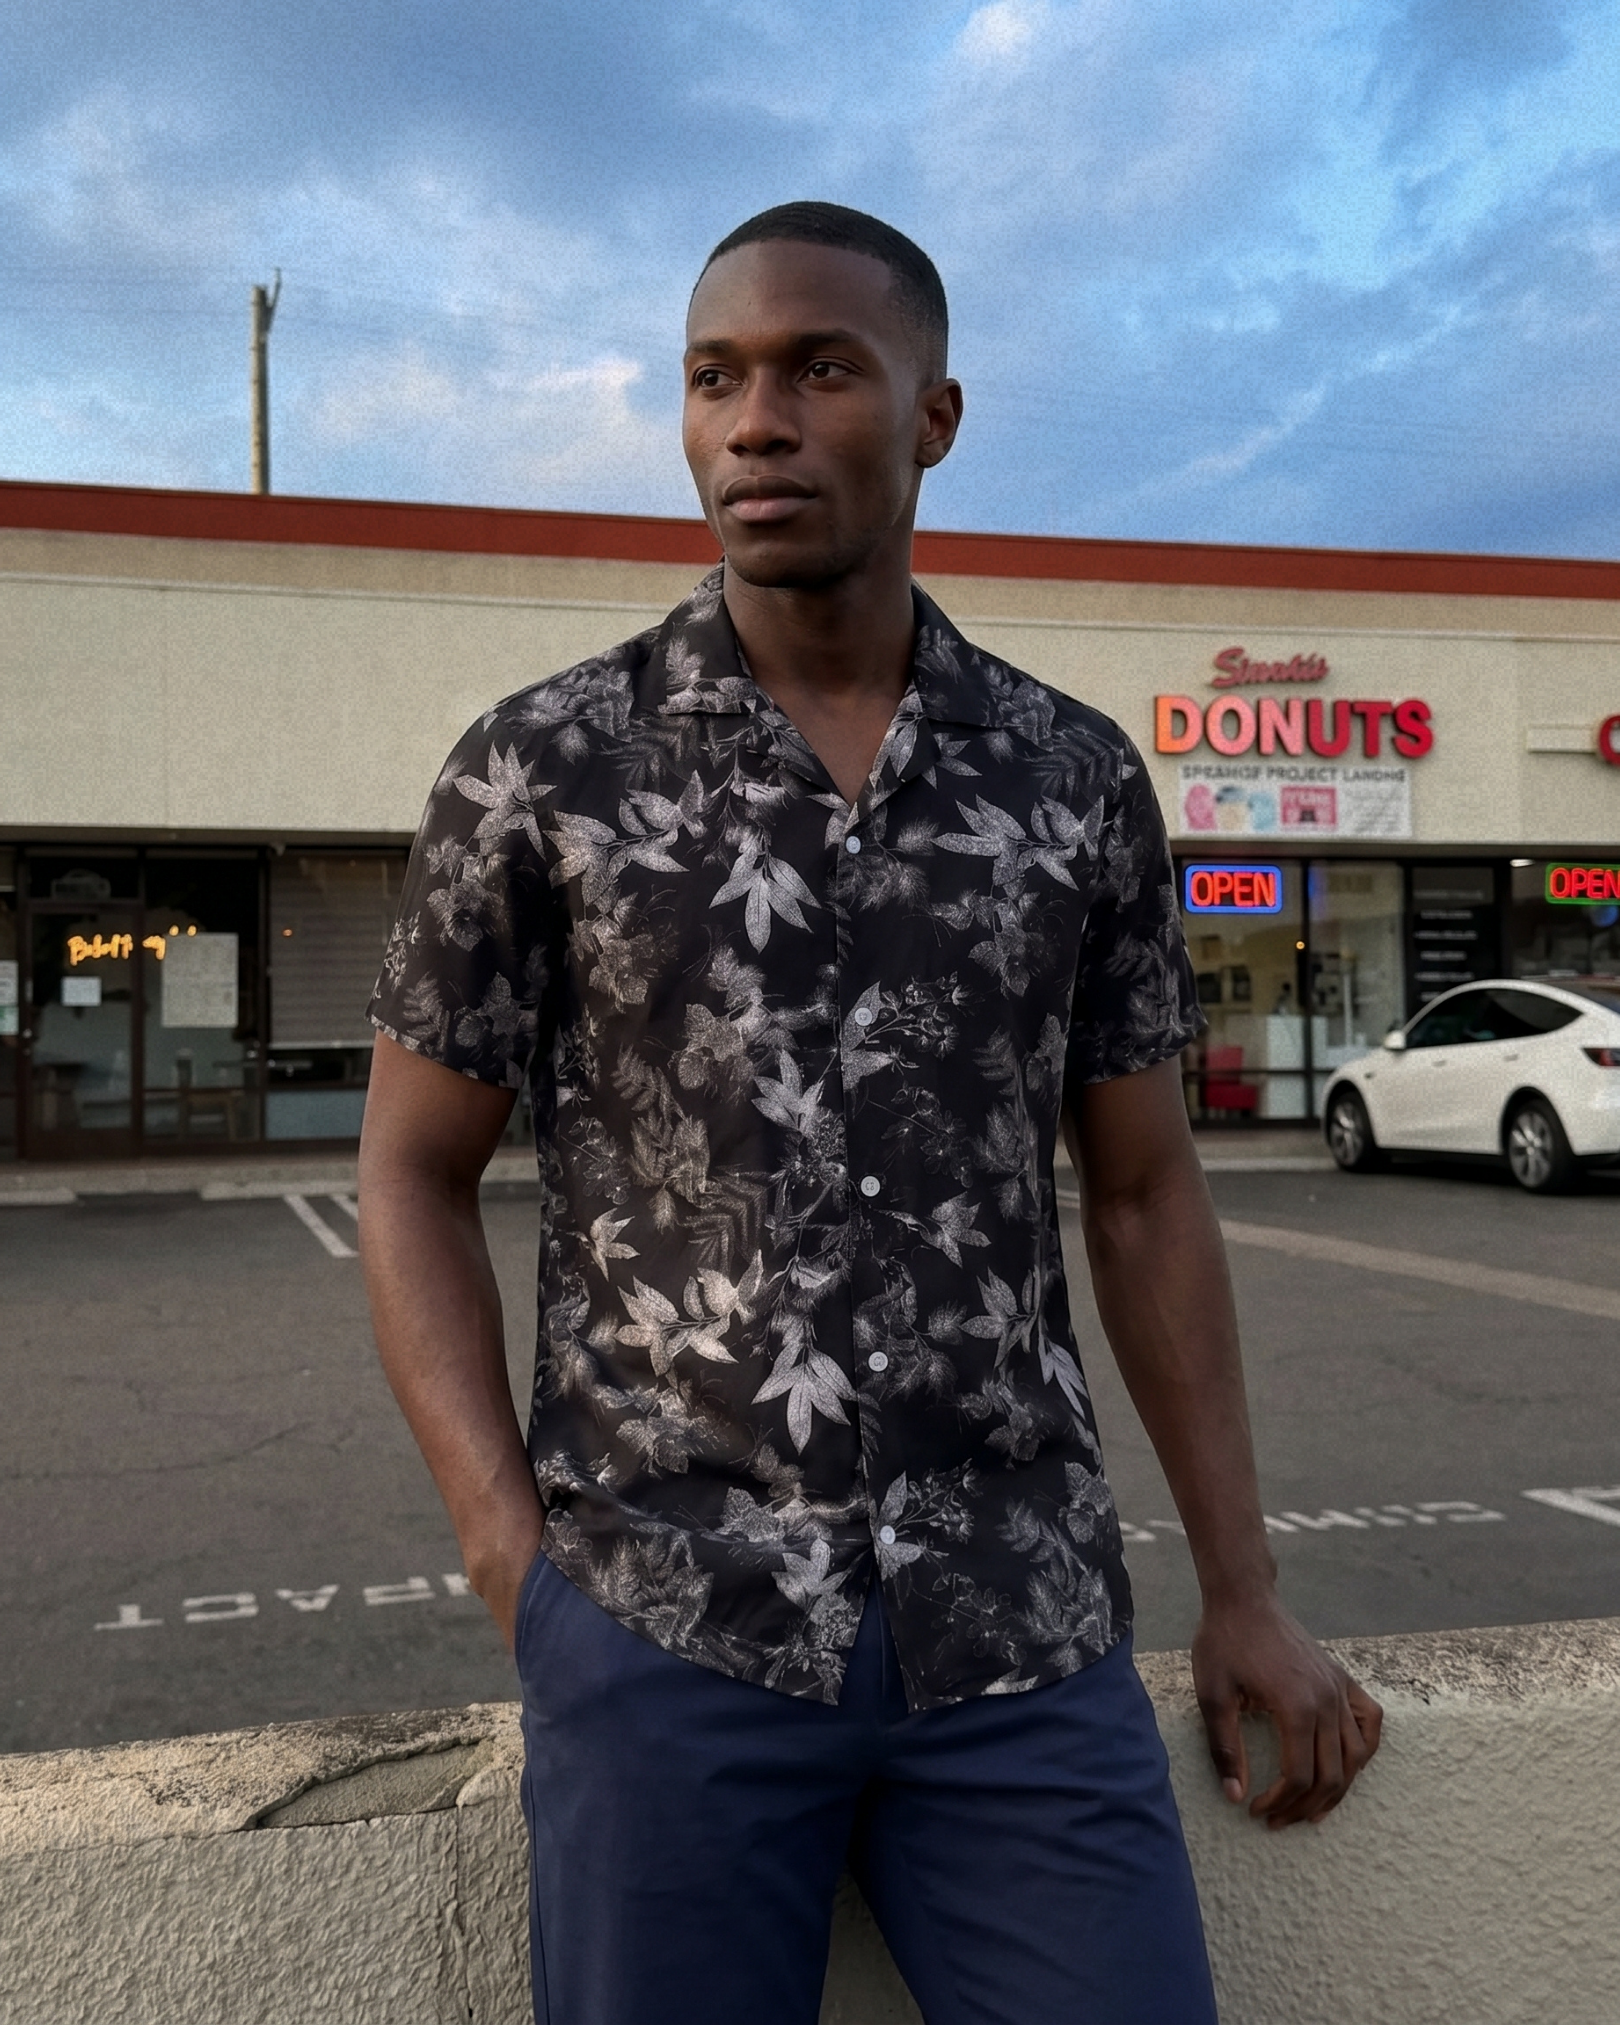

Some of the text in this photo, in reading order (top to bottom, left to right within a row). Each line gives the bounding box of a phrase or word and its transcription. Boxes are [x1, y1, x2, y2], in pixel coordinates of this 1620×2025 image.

[1154, 694, 1434, 758] DONUTS
[1266, 765, 1338, 783] PROJECT
[1190, 870, 1276, 907] OPEN
[1549, 866, 1620, 899] OPEN
